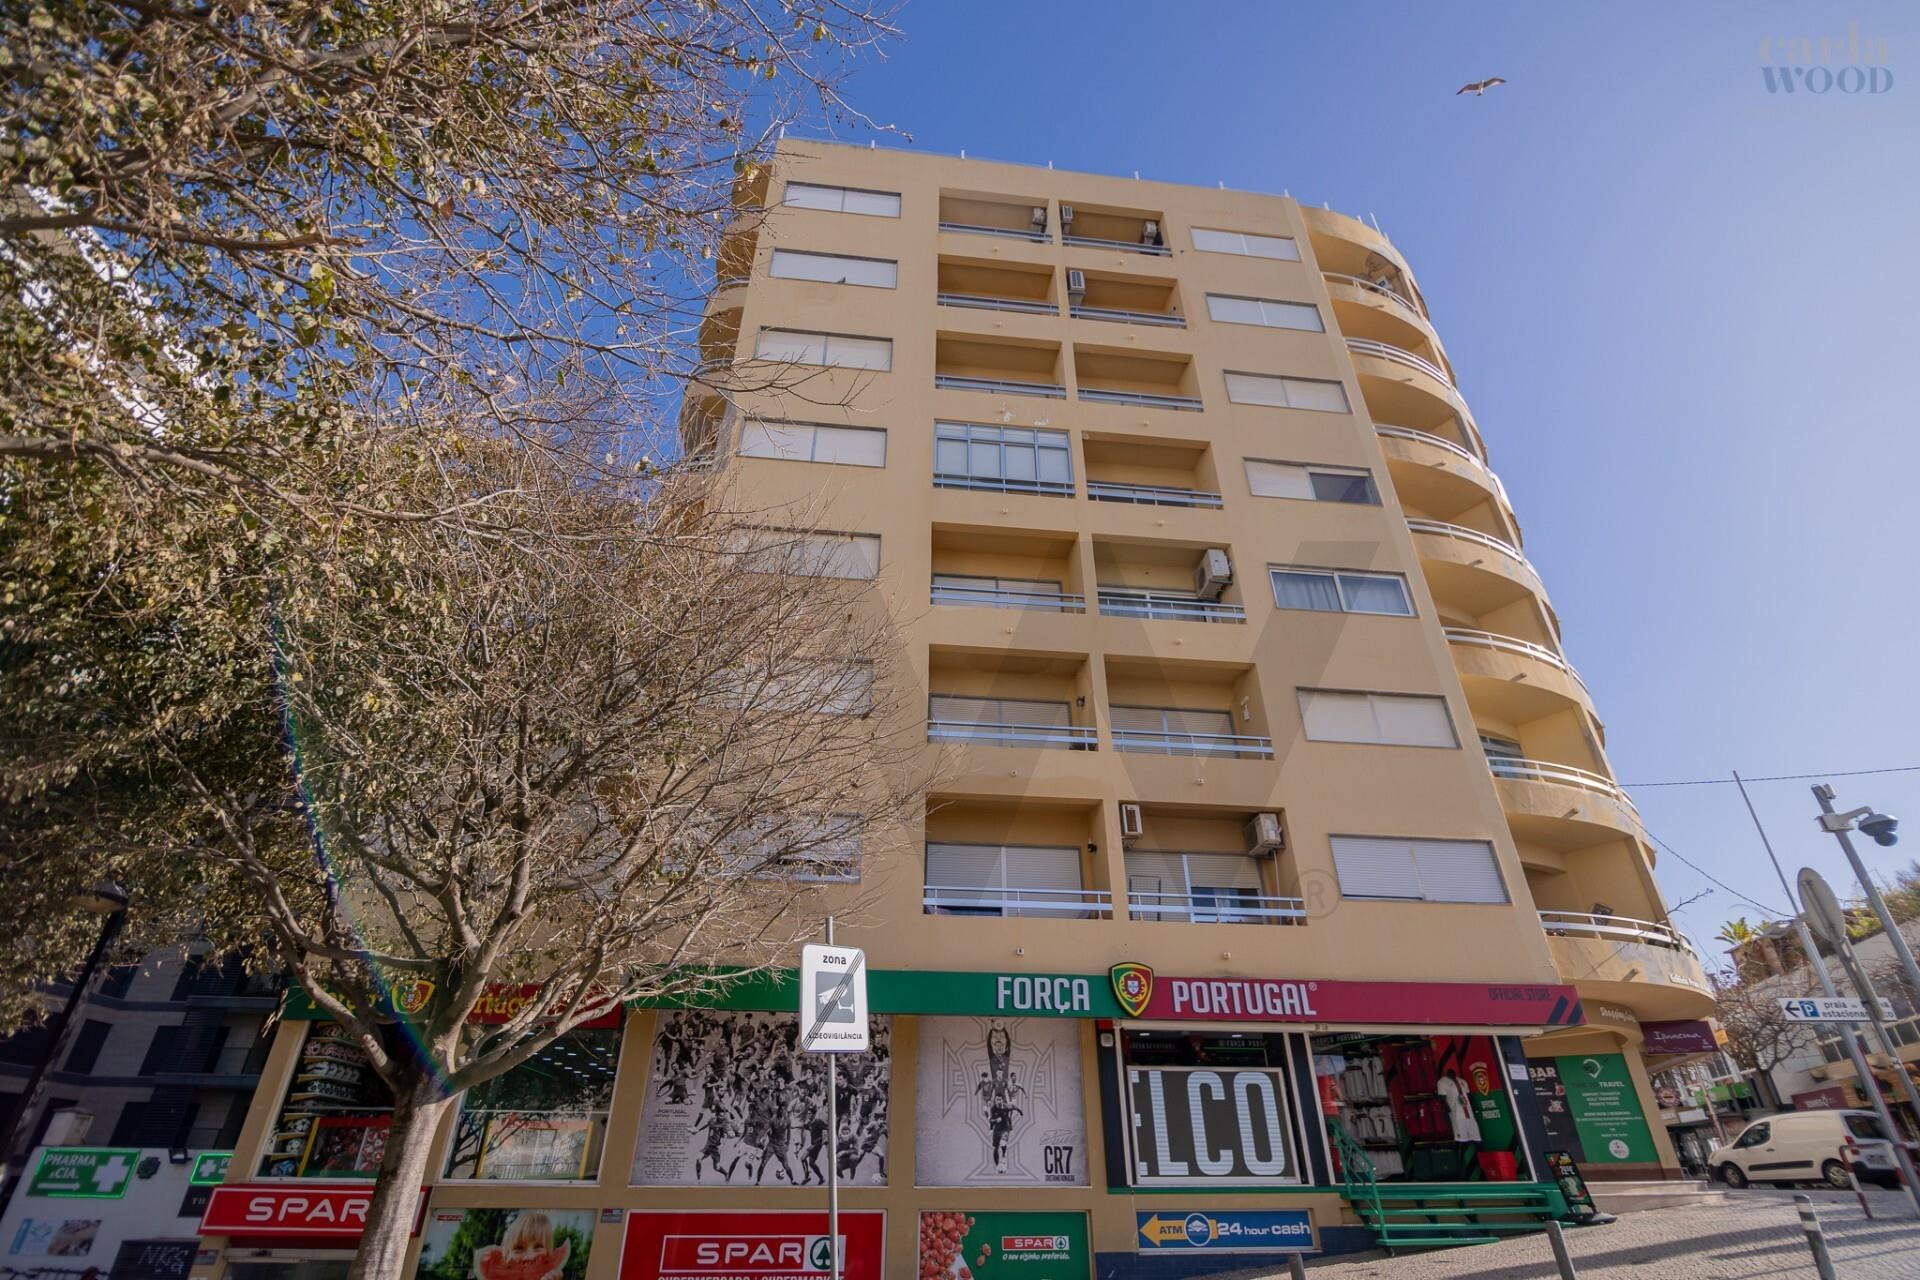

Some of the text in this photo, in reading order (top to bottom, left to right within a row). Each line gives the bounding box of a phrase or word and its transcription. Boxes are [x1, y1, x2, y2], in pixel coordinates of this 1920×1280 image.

[823, 955, 847, 965] zona
[997, 976, 1090, 1014] FORÇA
[1525, 988, 1552, 1001] STORE
[808, 1032, 862, 1040] DEOVIGILÂNCIA
[1529, 1066, 1557, 1078] BAR
[1130, 1070, 1286, 1177] LCO
[45, 1155, 96, 1167] PHARMA
[1044, 1145, 1074, 1175] CR7
[246, 1197, 370, 1223] SPAR
[1160, 1222, 1311, 1235] ATM 24 hour cash
[1014, 1238, 1054, 1248] SPAR
[696, 1242, 802, 1264] SPAR
